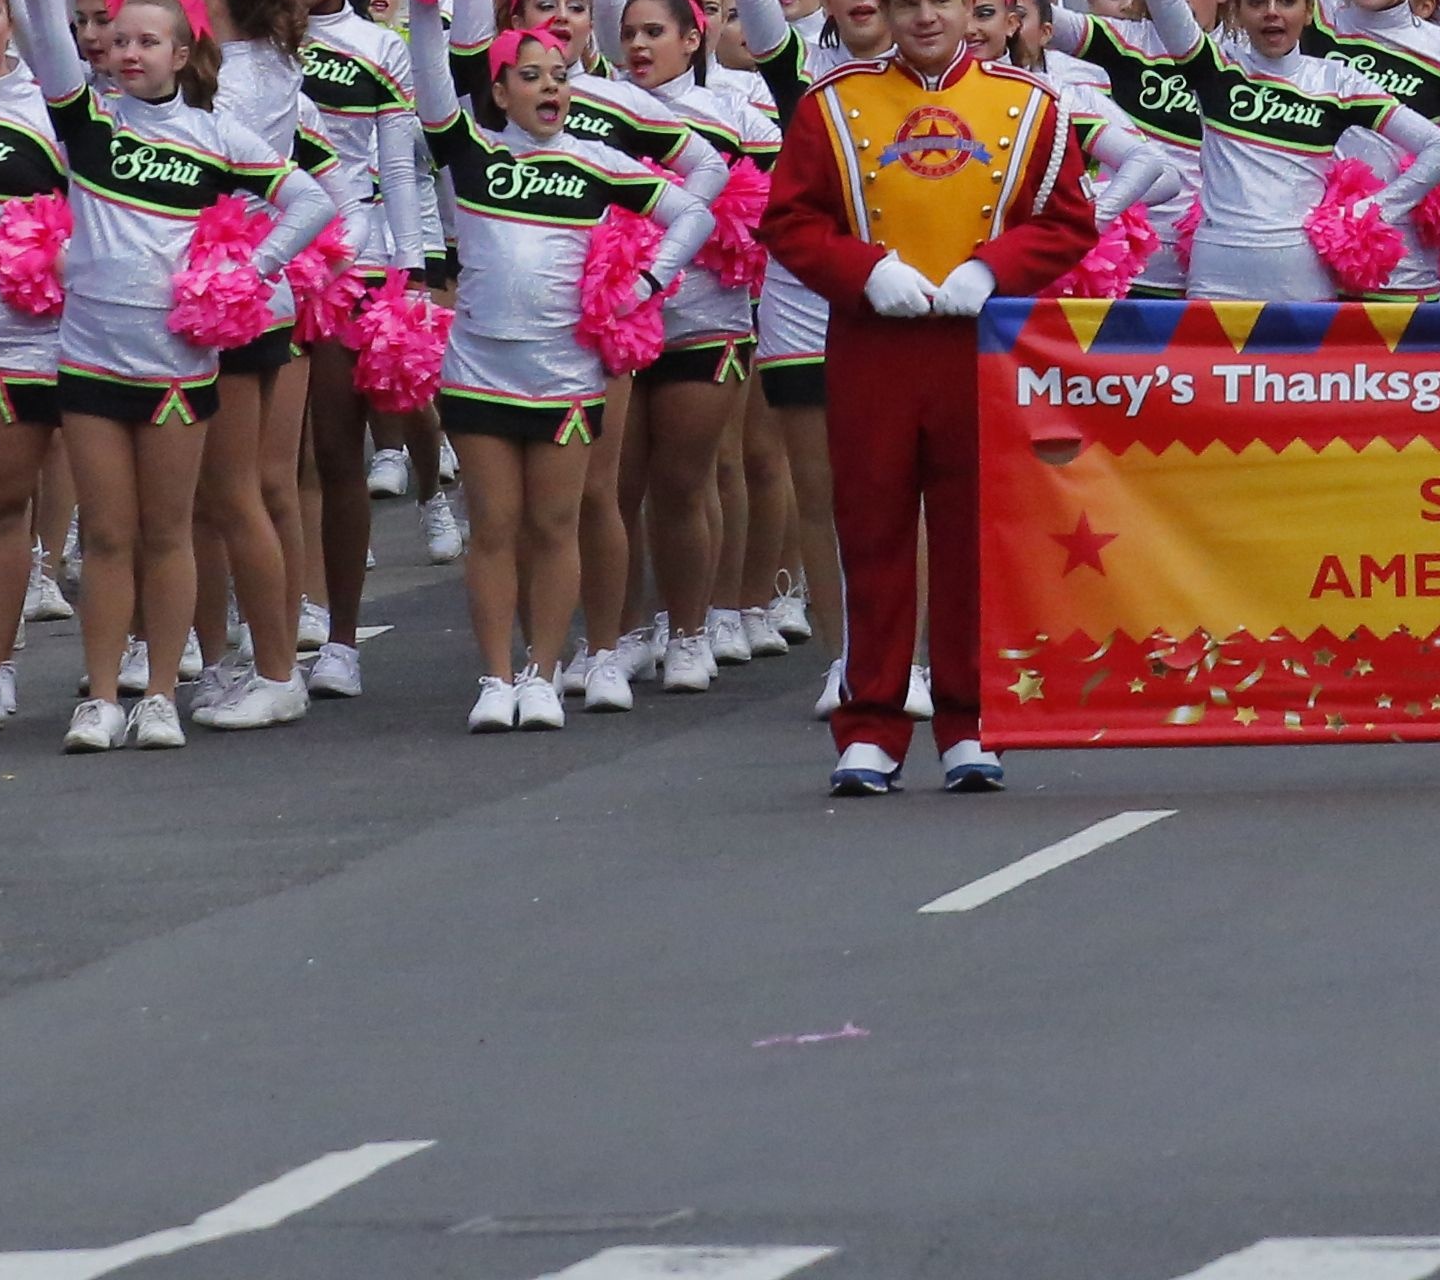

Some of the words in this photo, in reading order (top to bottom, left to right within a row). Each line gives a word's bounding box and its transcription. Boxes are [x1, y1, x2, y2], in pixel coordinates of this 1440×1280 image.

[1229, 84, 1327, 128] Spirit
[110, 139, 204, 187] Spirit
[486, 162, 588, 200] Spirit
[1016, 364, 1194, 417] Macy's
